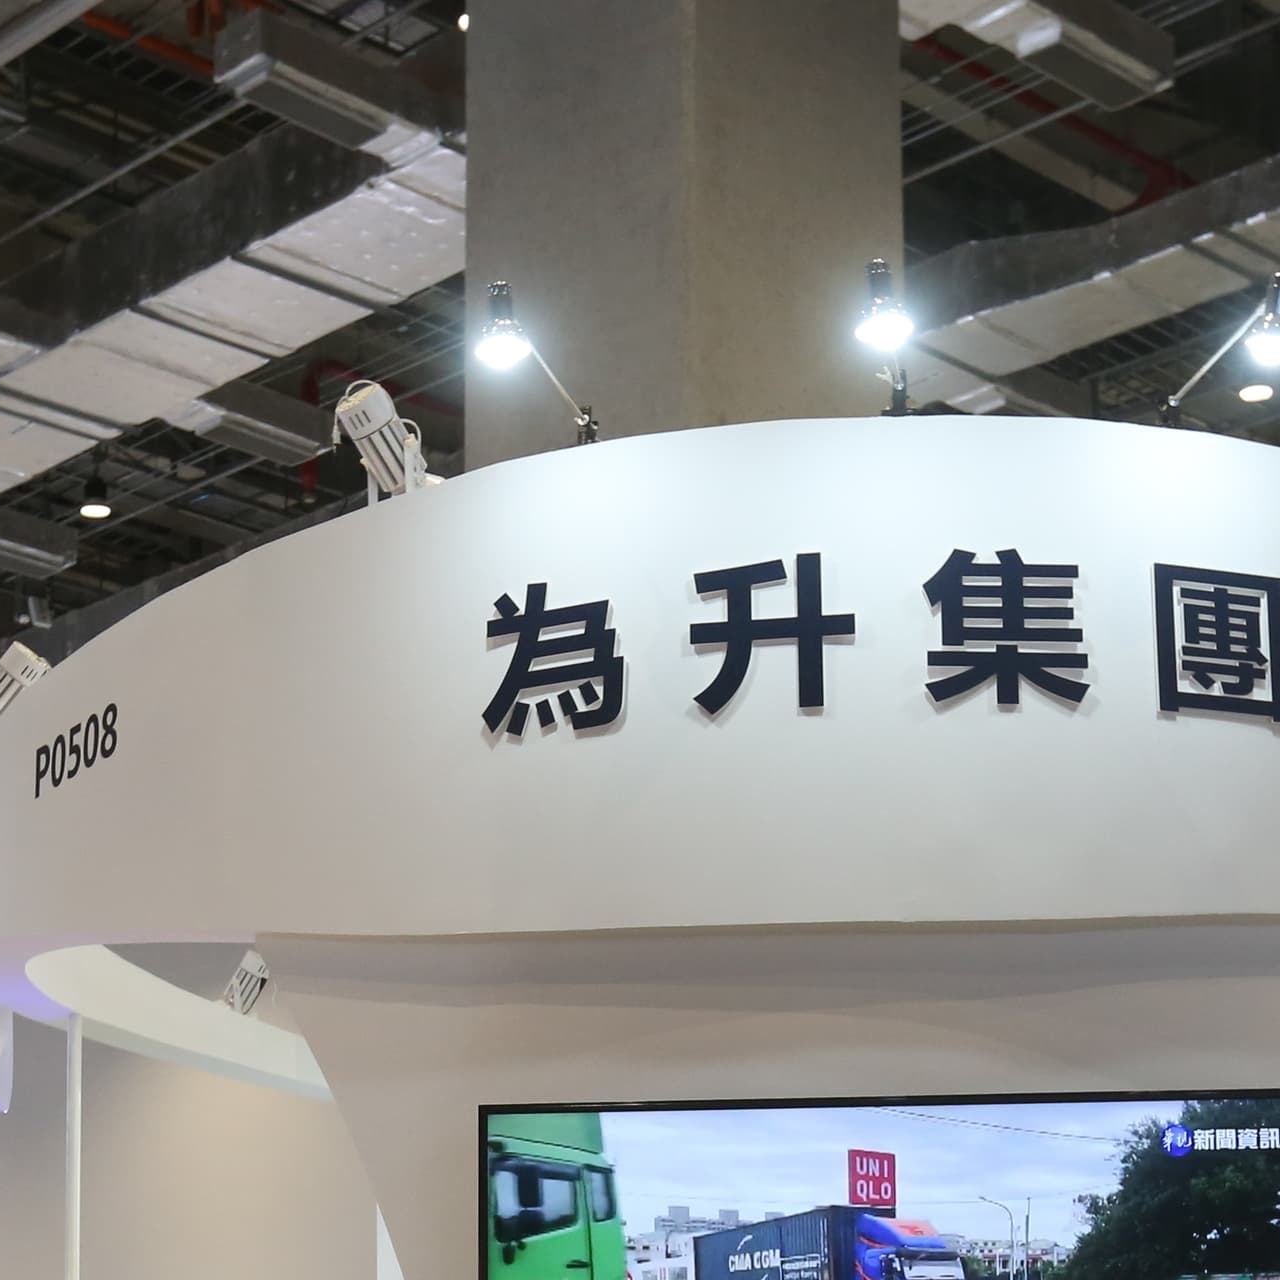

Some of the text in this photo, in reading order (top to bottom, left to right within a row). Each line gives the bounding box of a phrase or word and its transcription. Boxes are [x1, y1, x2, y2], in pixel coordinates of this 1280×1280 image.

[35, 703, 118, 800] P0508
[855, 1156, 888, 1178] UNI
[856, 1179, 892, 1201] QLO
